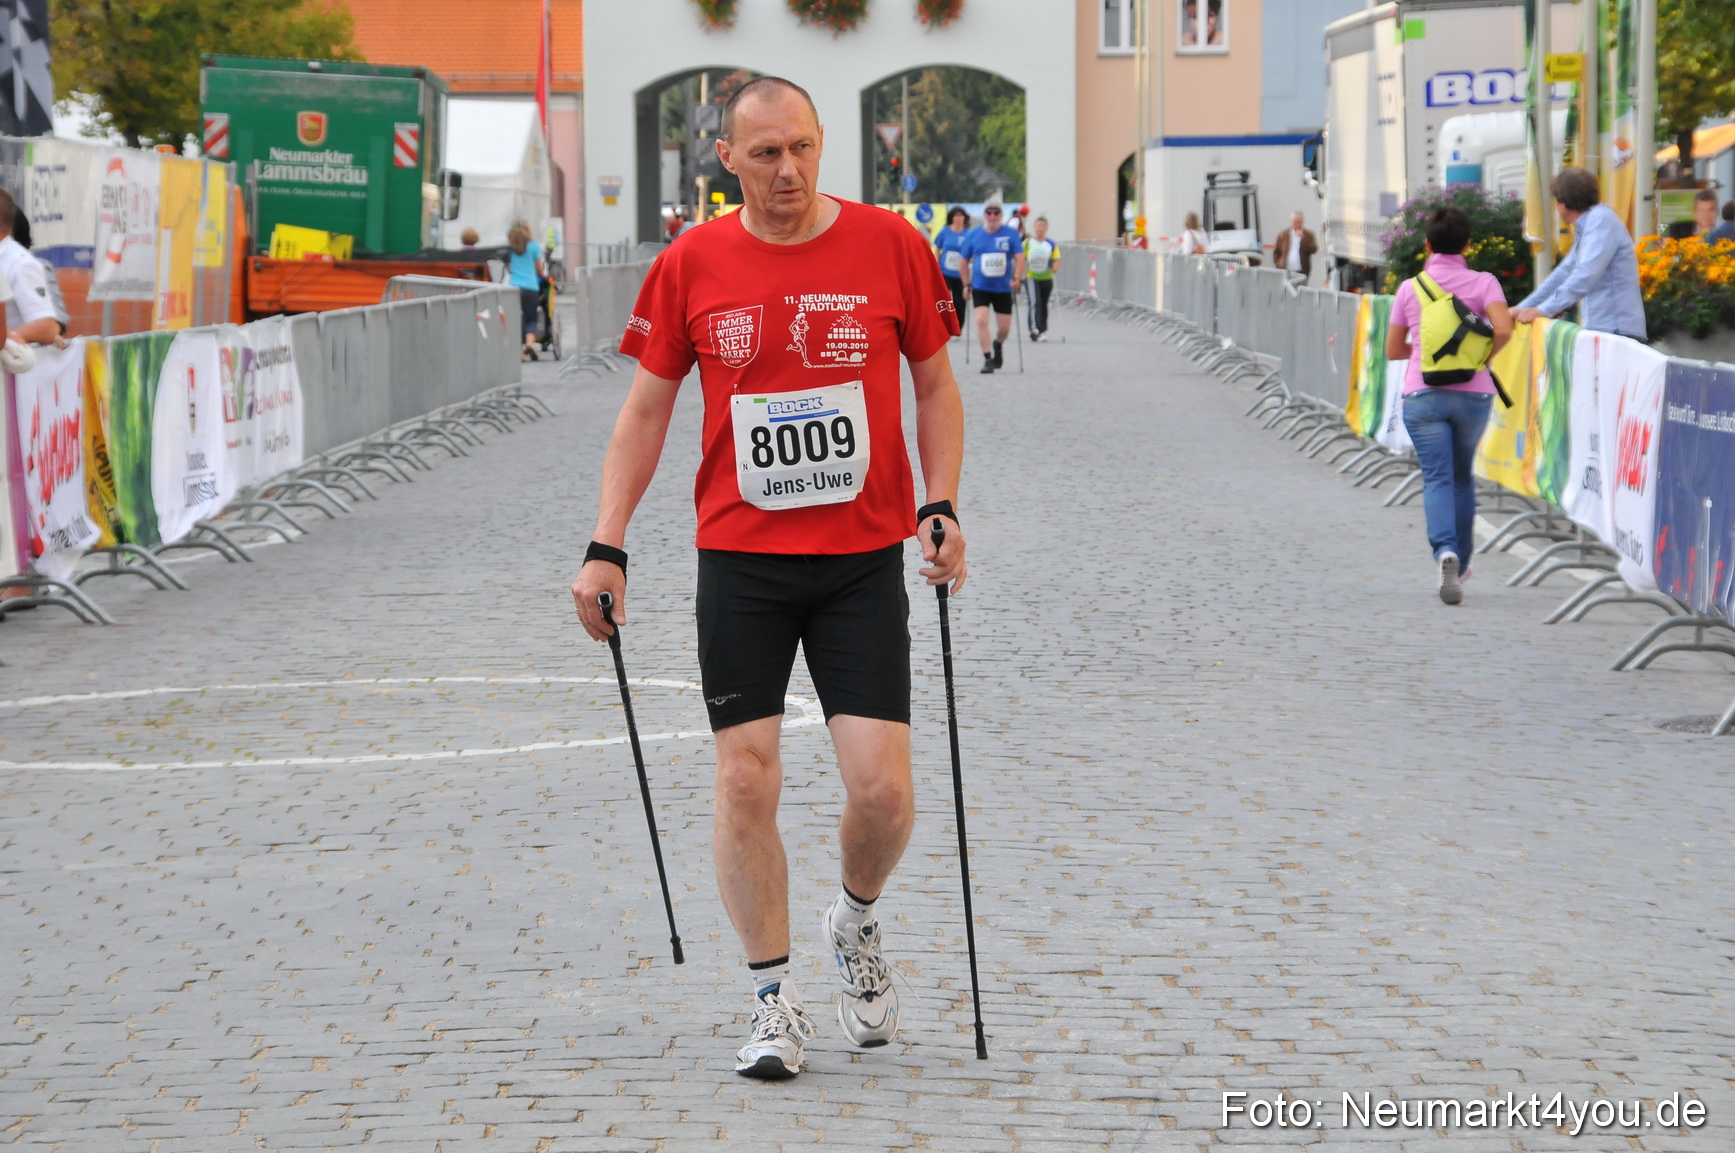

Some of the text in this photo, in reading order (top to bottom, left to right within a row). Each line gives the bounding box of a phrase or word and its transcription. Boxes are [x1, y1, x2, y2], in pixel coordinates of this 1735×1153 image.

[269, 146, 353, 165] Neumarkter
[253, 159, 368, 185] Lammsbräu
[784, 293, 868, 305] 11. NEUMARKTER
[797, 302, 856, 312] STADTLAUF
[717, 315, 753, 329] IMMER
[715, 324, 755, 339] WIEDER
[718, 334, 751, 352] NEU
[825, 342, 869, 350] 19.09.2010
[719, 348, 752, 359] MARKT
[768, 396, 824, 415] BOCK
[750, 416, 856, 469] 8009
[762, 471, 853, 497] Jens-Uwe
